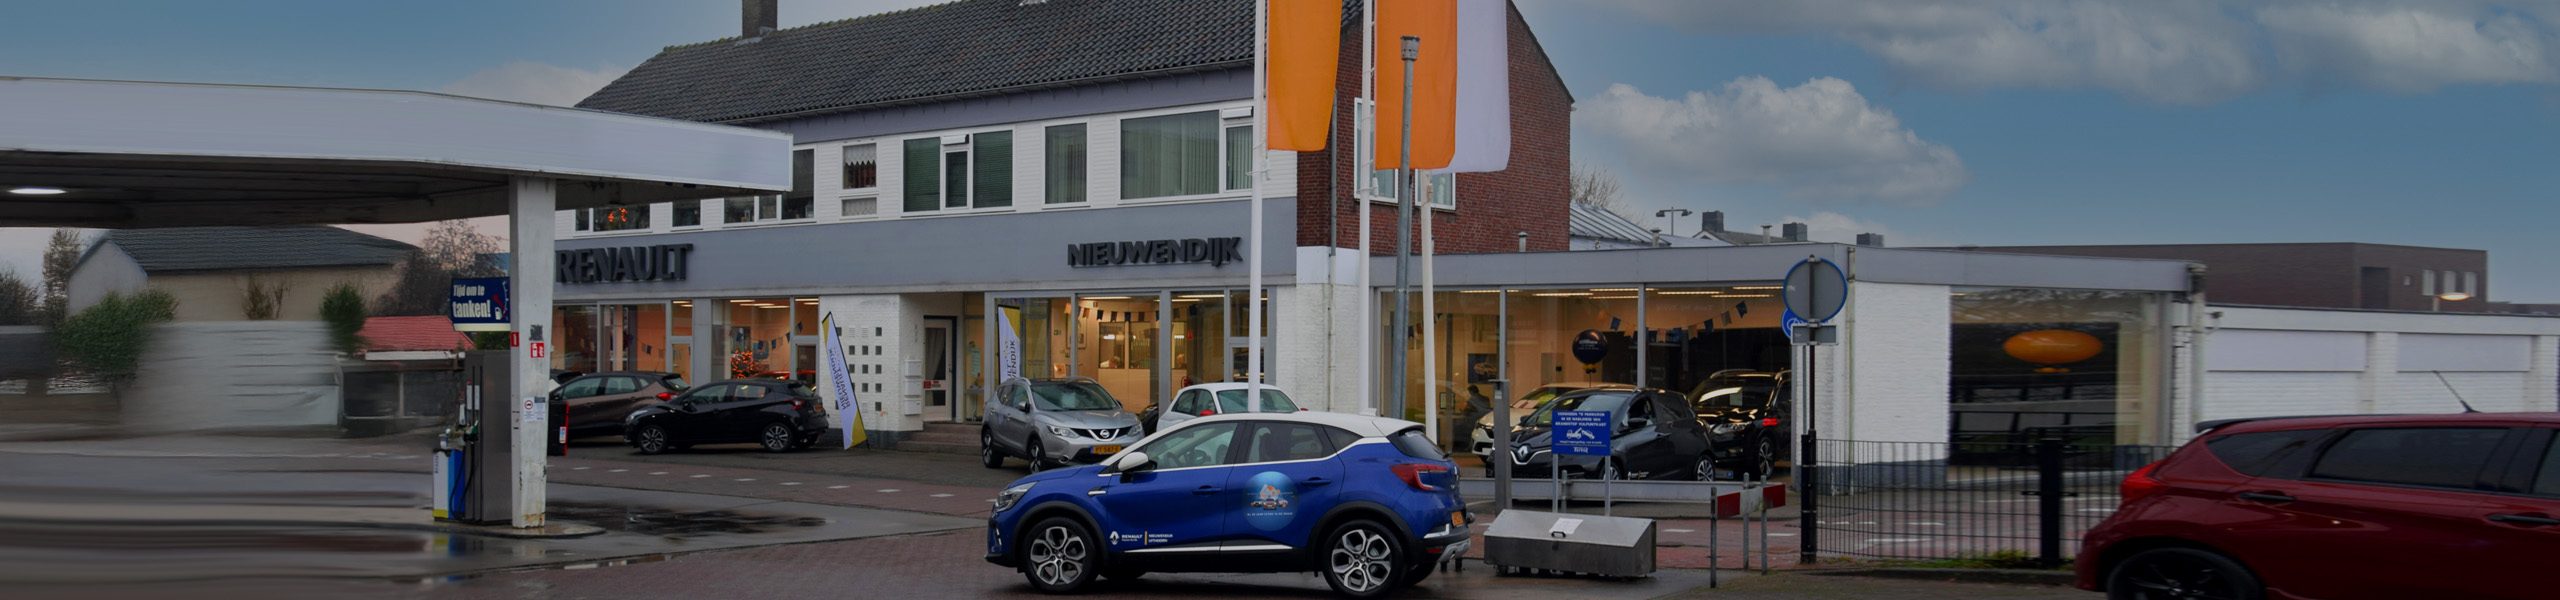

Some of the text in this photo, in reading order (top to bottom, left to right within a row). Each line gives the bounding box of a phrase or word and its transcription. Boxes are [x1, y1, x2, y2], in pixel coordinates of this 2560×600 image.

[555, 243, 694, 284] RENAULT
[1067, 236, 1243, 268] NIEUWENDIJK
[453, 284, 485, 297] Tijd om te
[452, 299, 491, 318] tanken!
